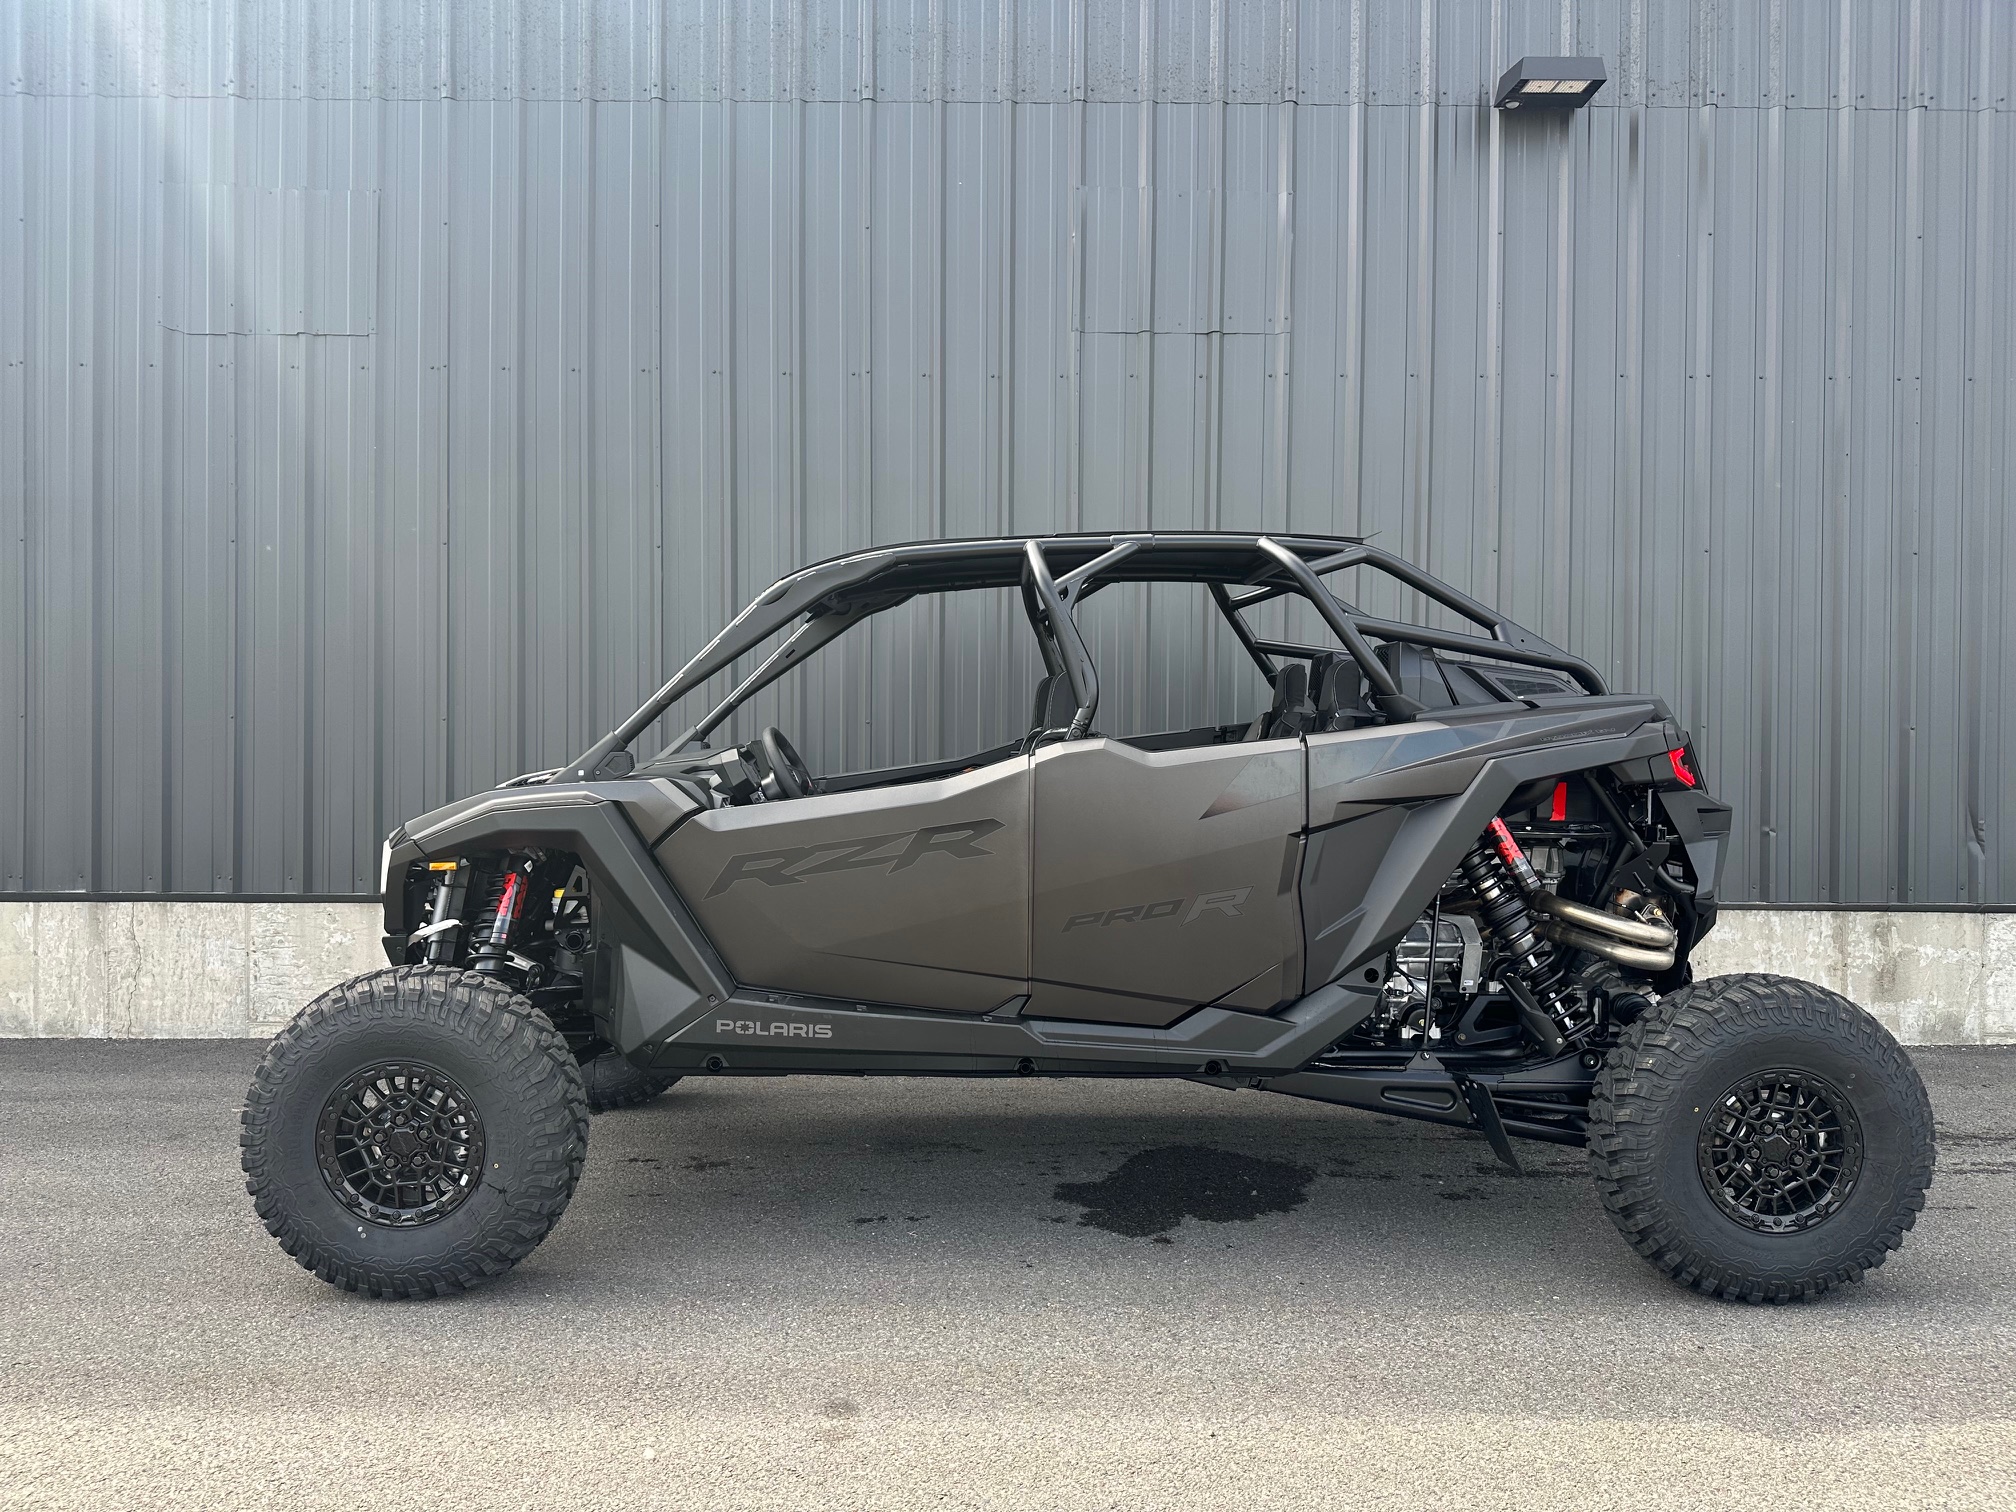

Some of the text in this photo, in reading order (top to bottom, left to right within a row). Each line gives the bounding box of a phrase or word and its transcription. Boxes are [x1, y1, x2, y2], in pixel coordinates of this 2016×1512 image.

[702, 817, 1006, 900] RZR
[1061, 885, 1254, 933] PRO R
[716, 1019, 833, 1038] POLARIS
